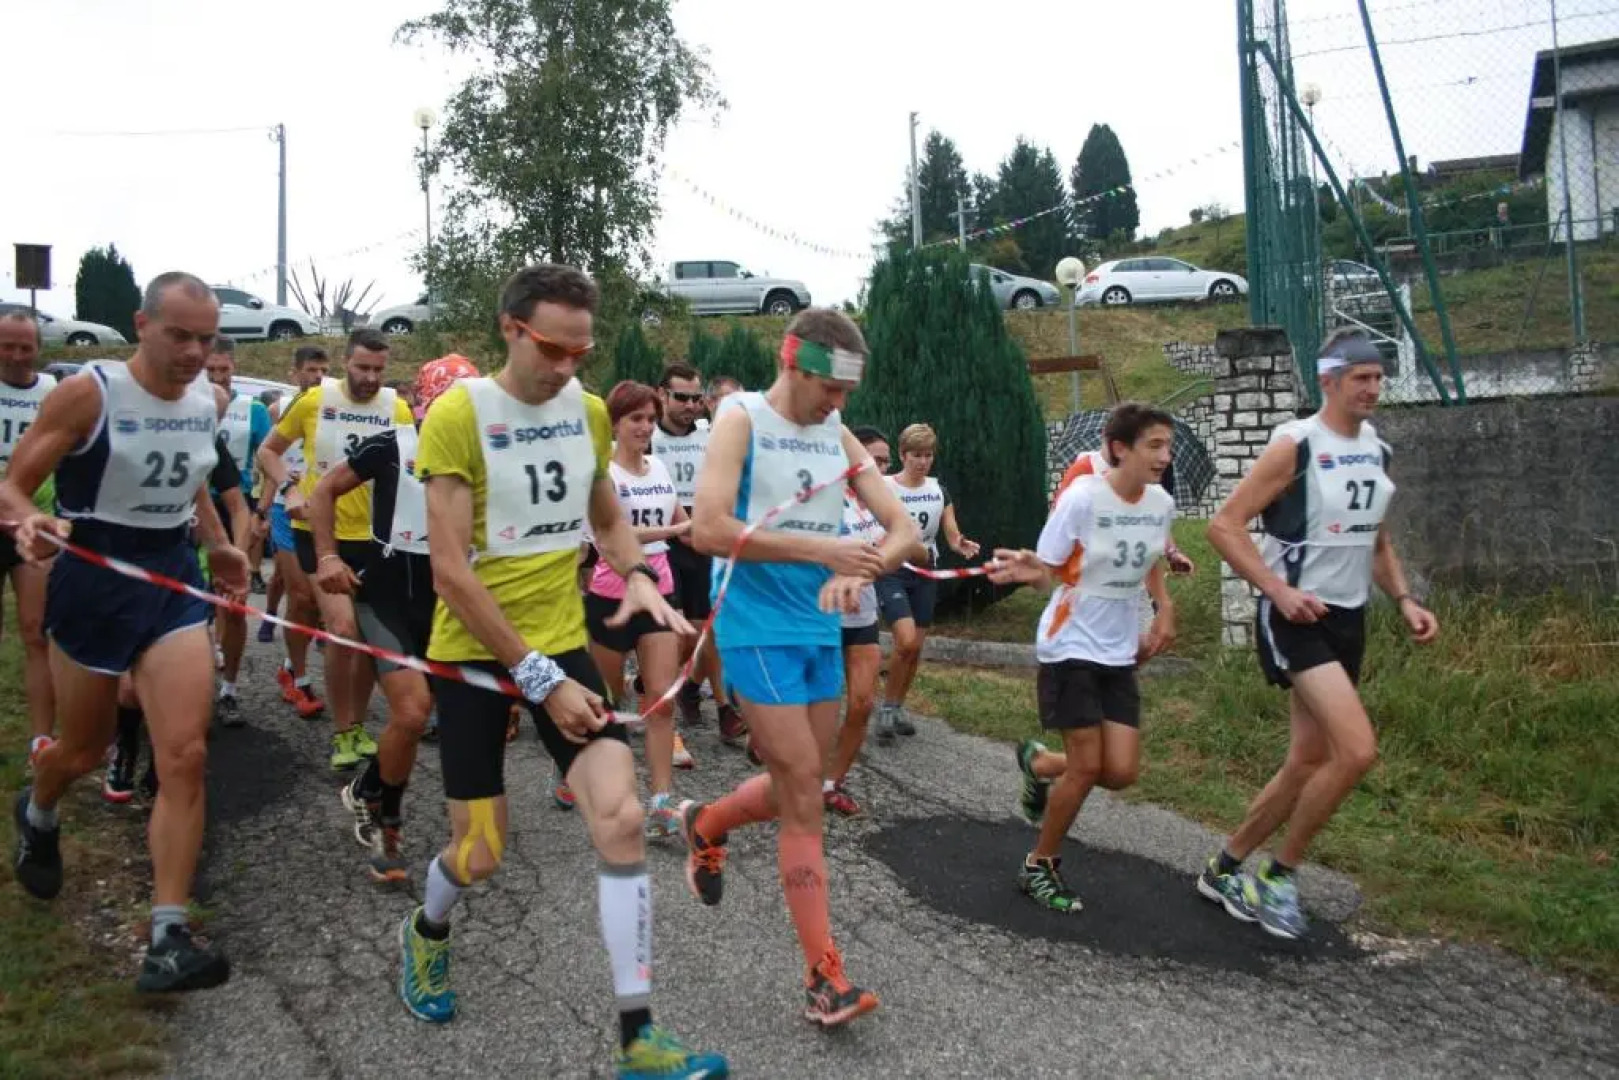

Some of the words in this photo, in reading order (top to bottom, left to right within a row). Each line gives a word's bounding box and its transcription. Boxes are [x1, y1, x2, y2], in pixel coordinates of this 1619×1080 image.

[144, 416, 212, 433] sportful
[339, 411, 390, 426] sportful
[514, 419, 583, 445] sportful
[778, 437, 840, 455] sportful
[139, 450, 190, 487] 25
[675, 461, 695, 482] 19
[524, 460, 567, 505] 13
[630, 484, 673, 496] sportful
[796, 468, 813, 504] 3
[901, 493, 941, 503] sportful
[1346, 479, 1377, 510] 27
[1113, 540, 1147, 568] 33
